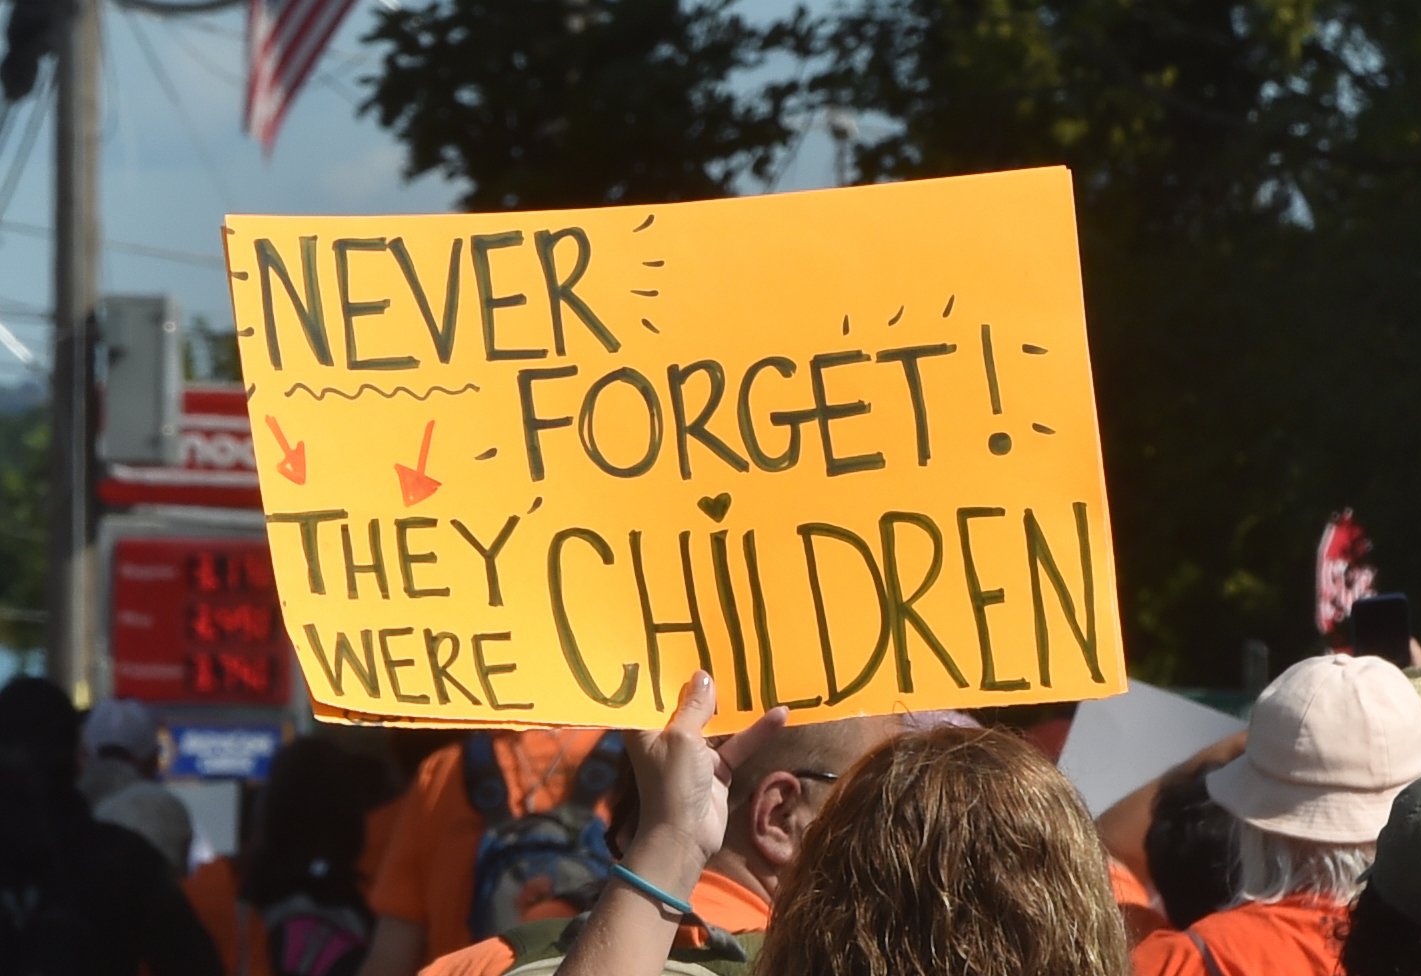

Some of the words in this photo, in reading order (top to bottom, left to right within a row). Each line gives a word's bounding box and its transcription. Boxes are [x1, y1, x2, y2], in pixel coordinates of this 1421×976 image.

[254, 226, 622, 370] NEVER
[518, 324, 1013, 481] FORGET!
[266, 509, 520, 607] THEY
[303, 623, 534, 710] WERE
